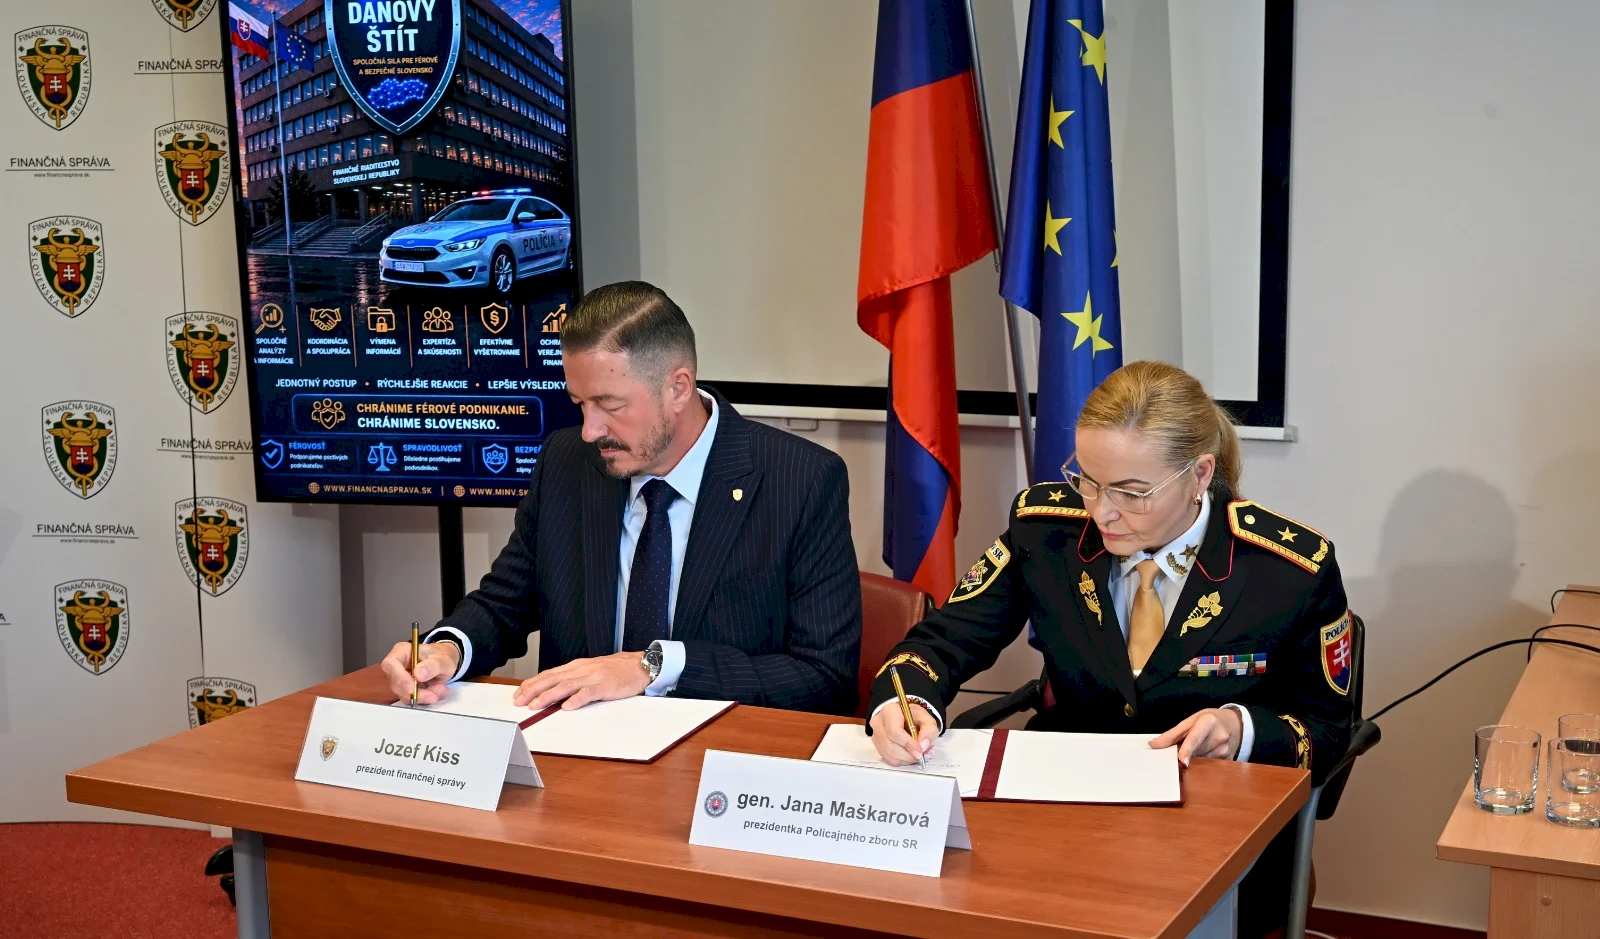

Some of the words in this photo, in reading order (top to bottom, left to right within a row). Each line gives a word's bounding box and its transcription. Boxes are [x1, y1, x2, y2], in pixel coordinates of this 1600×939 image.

[19, 27, 56, 42] FINANČNÁ
[58, 28, 86, 42] SPRÁVA
[367, 25, 418, 52] ŠTÍT
[139, 58, 192, 71] FINANČNÁ
[195, 58, 224, 69] SPRÁ
[353, 57, 386, 66] SPOLOČNÁ
[415, 56, 438, 64] FÉROVÉ
[17, 62, 47, 120] SLOVENSKÁ
[70, 61, 90, 117] REPUBLIKA
[158, 122, 195, 137] FINANČNÁ
[196, 123, 226, 137] SPRÁVA
[10, 156, 66, 167] FINANČNÁ
[69, 156, 110, 167] SPRÁVA
[369, 169, 400, 180] REPUBLIKY
[208, 156, 229, 213] REPUBLIKA
[33, 217, 70, 232] FINANČNÁ
[72, 219, 99, 232] SPRÁVA
[524, 234, 556, 253] POLÍCIA
[32, 252, 60, 307] SLOVENSKÁ
[84, 251, 103, 305] REPUBLIKA
[206, 315, 235, 328] SPRÁVA
[256, 337, 287, 345] SPOLOČNÉ
[308, 337, 349, 345] KOORDINÁCIA
[370, 337, 396, 345] VÝMENA
[312, 347, 351, 355] SPOLUPRÁCA
[474, 348, 520, 356] VYŠETROVANIE
[218, 346, 238, 401] REPUBLIKA
[276, 378, 320, 387] JEDNOTNÝ
[323, 380, 357, 388] POSTUP
[378, 378, 429, 389] RÝCHLEJŠIE
[431, 380, 468, 388] REAKCIE
[488, 379, 518, 389] LEPŠIE
[520, 379, 567, 390] VÝSLEDKY
[46, 402, 83, 417] FINANČNÁ
[84, 403, 112, 416] SPRÁVA
[357, 402, 413, 413] CHRÁNIME
[416, 402, 456, 414] FÉROVÉ
[460, 405, 529, 415] PODNIKANIE.
[358, 416, 421, 429] CHRÁNIME
[425, 419, 500, 430] SLOVENSKO.
[162, 438, 212, 450] FINANČNÁ
[289, 442, 326, 450] FÉROVOSŤ
[403, 444, 463, 452] SPRAVODLIVOSŤ
[44, 435, 73, 488] SLOVENSKÁ
[97, 434, 116, 487] REPUBLIKA
[324, 485, 432, 494] WWW.FINANCNASPRAVA.SK
[216, 501, 244, 514] SPRÁVA
[37, 522, 92, 534] FINANČNÁ
[95, 524, 135, 535] SPRÁVA
[227, 532, 247, 585] REPUBLIKA
[993, 548, 1004, 560] SR
[58, 580, 96, 594] FINANČNÁ
[97, 582, 124, 595] SPRÁVA
[58, 613, 85, 665] SLOVENSKÁ
[109, 613, 128, 664] REPUBLIKA
[225, 681, 253, 694] SPRÁVA
[374, 739, 421, 759] Jozef
[423, 745, 461, 766] Kiss
[356, 764, 395, 778] prezident
[397, 769, 436, 785] finančnej
[437, 775, 466, 790] správy
[737, 792, 775, 810] gen.
[781, 795, 824, 815] Jana
[830, 801, 930, 828] Maškarová
[744, 820, 802, 835] prezidentka
[806, 827, 866, 843] Policajného
[869, 834, 899, 848] zboru
[902, 839, 918, 850] SR
